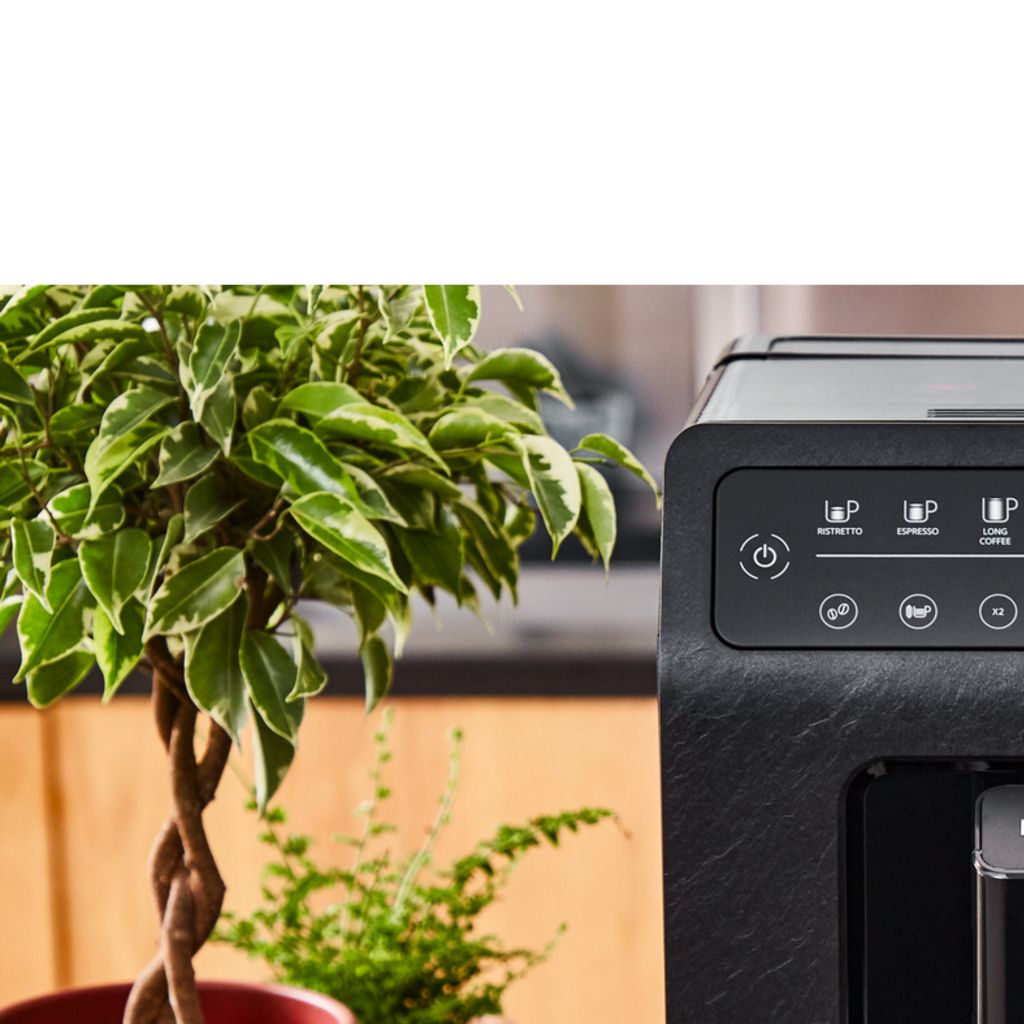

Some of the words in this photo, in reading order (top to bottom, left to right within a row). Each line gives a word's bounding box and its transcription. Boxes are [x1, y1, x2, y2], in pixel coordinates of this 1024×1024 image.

[816, 527, 863, 536] RISTRETTO
[896, 527, 940, 536] ESPRESSO
[982, 527, 1009, 536] LONG
[978, 536, 1011, 545] COFFEE
[991, 607, 1005, 616] X2
